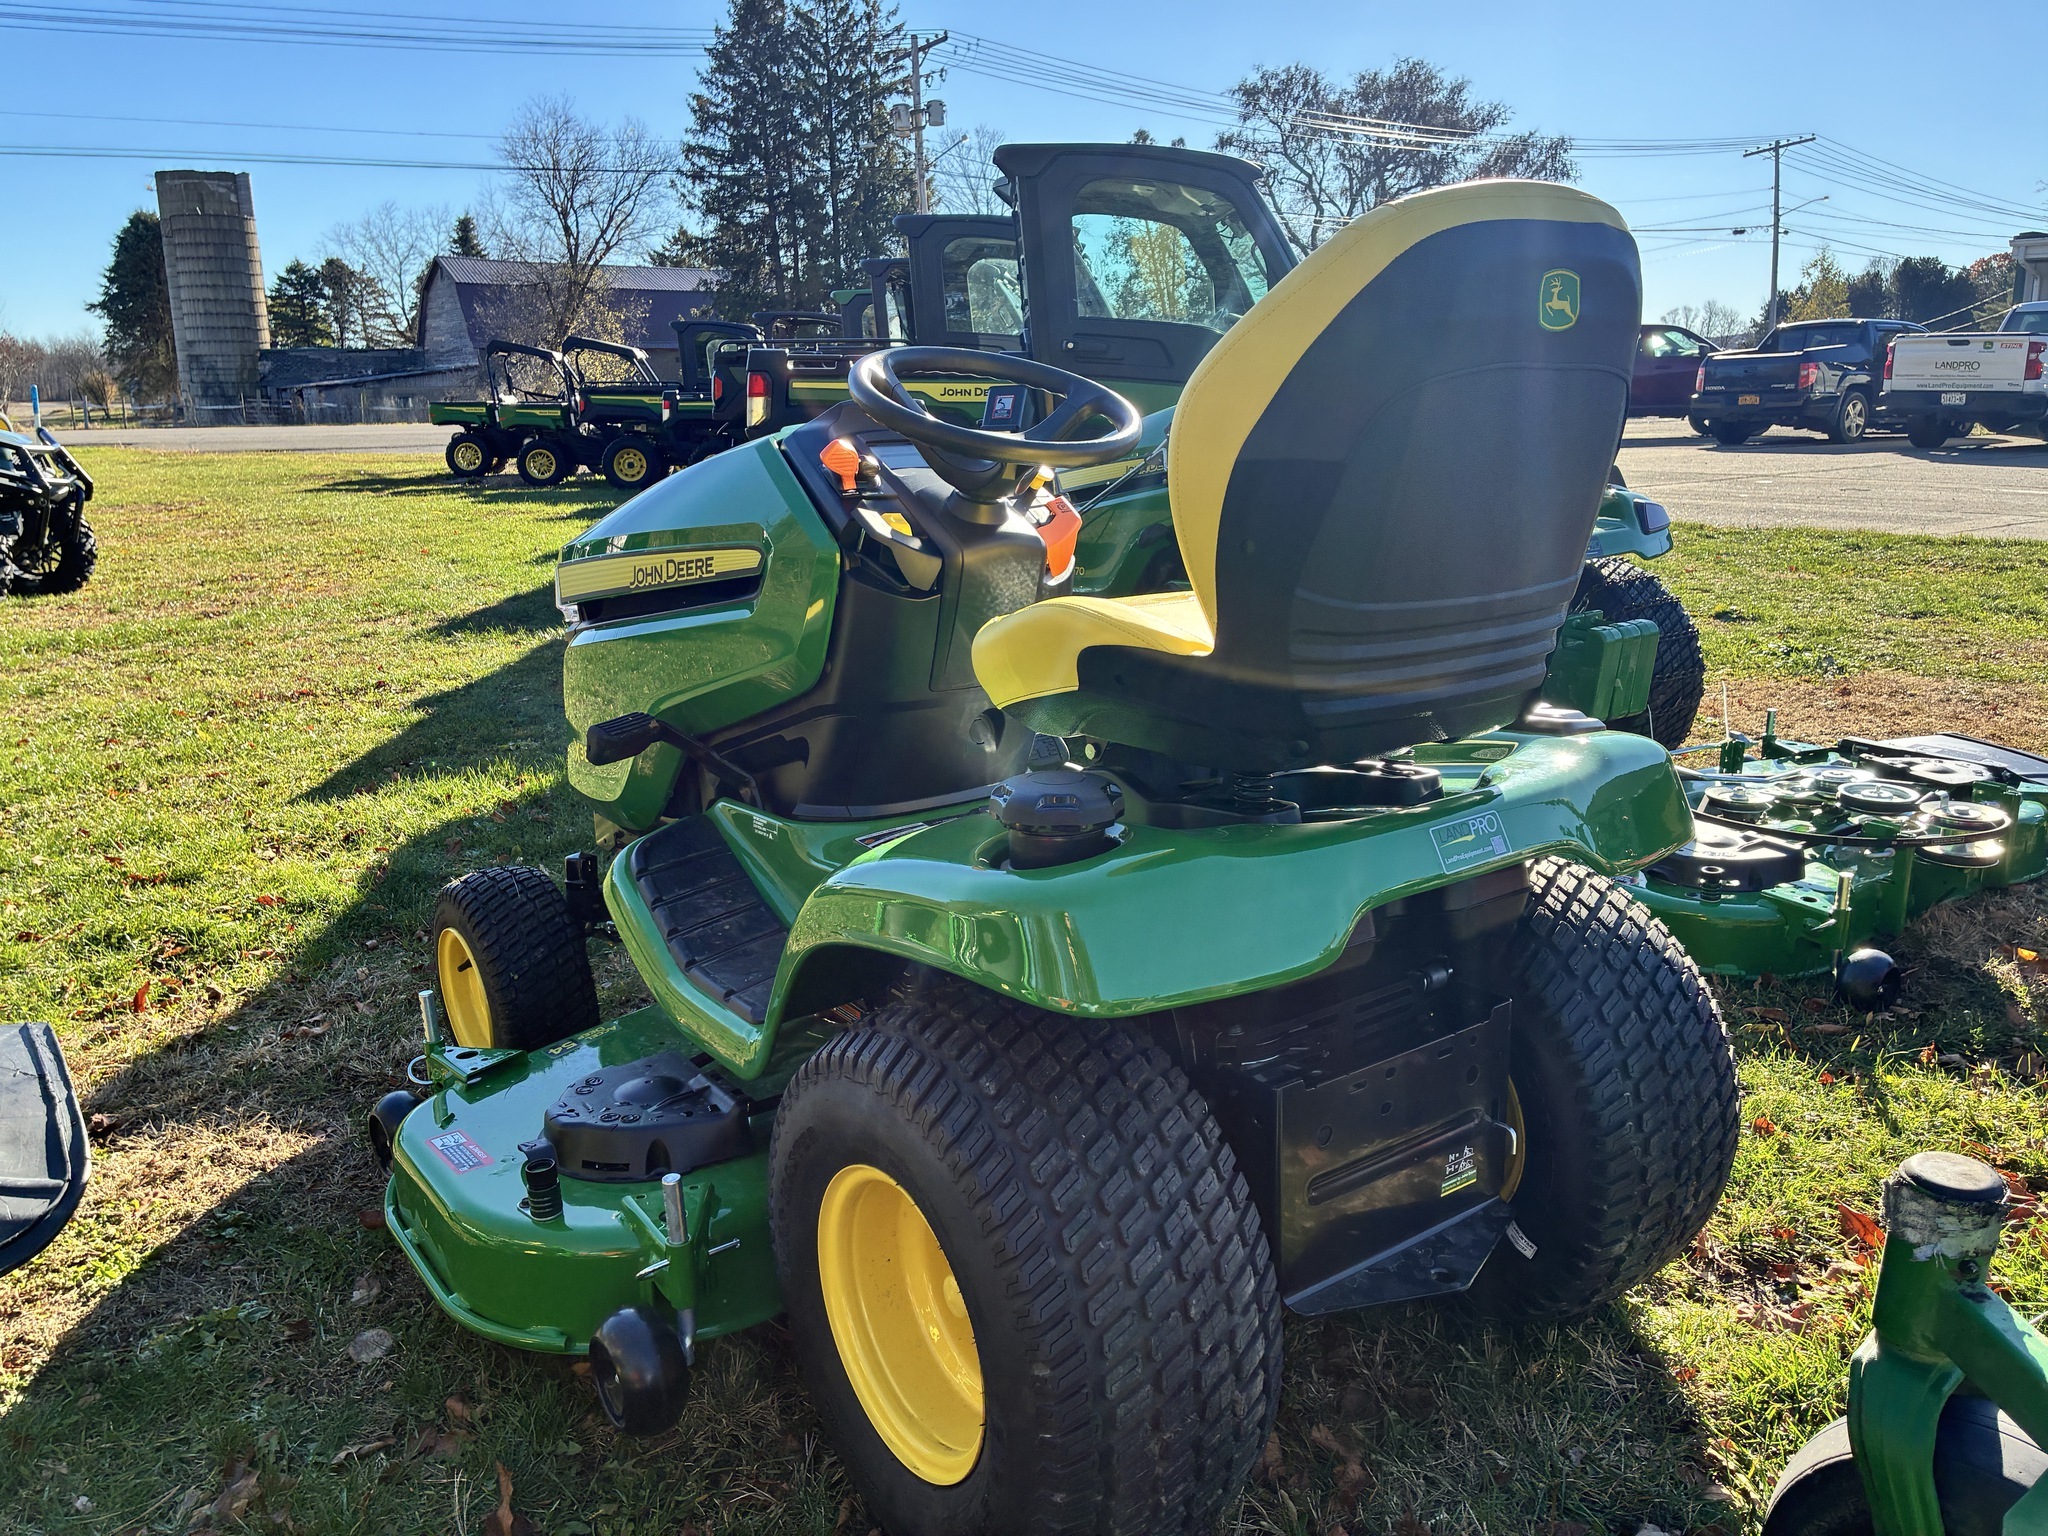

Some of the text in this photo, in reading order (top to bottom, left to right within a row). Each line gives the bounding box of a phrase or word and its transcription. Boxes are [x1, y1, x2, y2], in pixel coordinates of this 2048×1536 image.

[1934, 360, 1981, 371] LANDPRO
[940, 386, 972, 397] JOHN
[629, 555, 716, 587] JOHN DEERE
[1437, 814, 1498, 844] LANDPRO
[548, 1040, 578, 1055] 54
